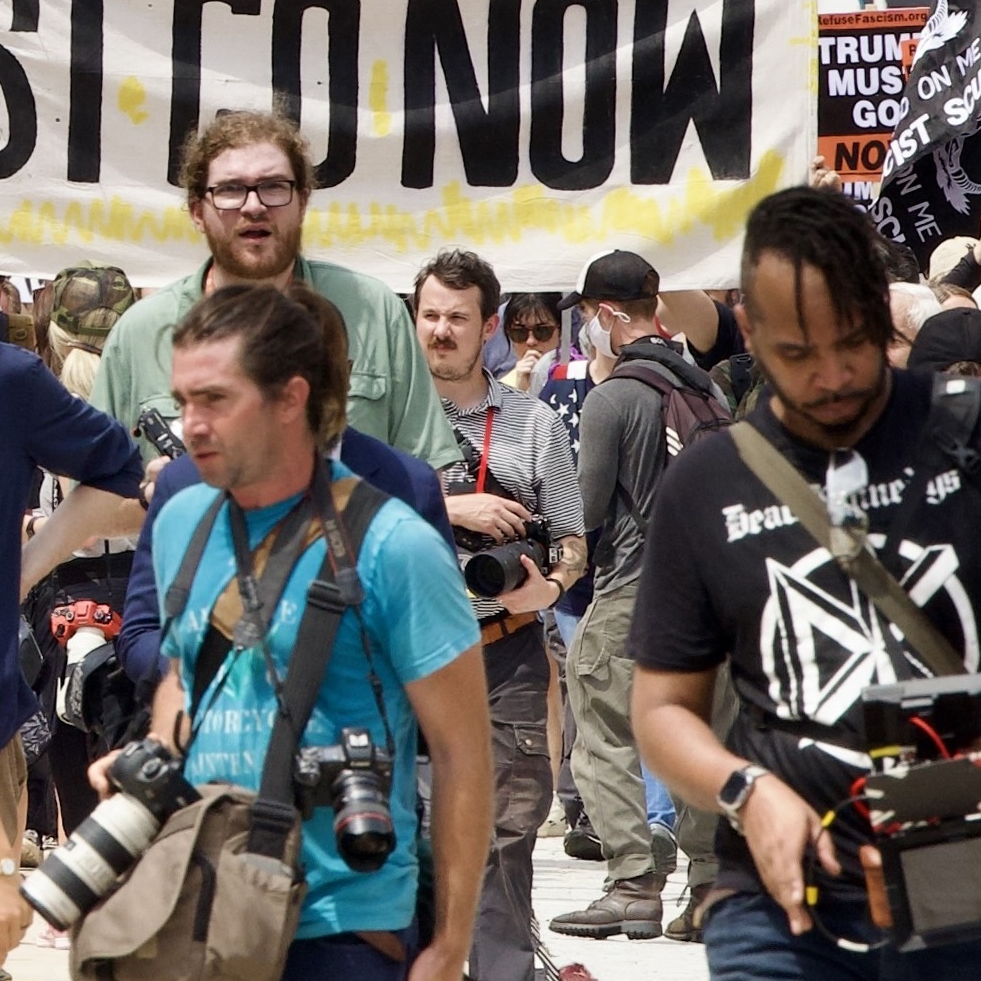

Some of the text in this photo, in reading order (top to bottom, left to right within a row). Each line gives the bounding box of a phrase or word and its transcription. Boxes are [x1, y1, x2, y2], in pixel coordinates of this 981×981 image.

[828, 65, 904, 97] MUS
[917, 36, 981, 100] ON ME
[834, 139, 891, 171] NO
